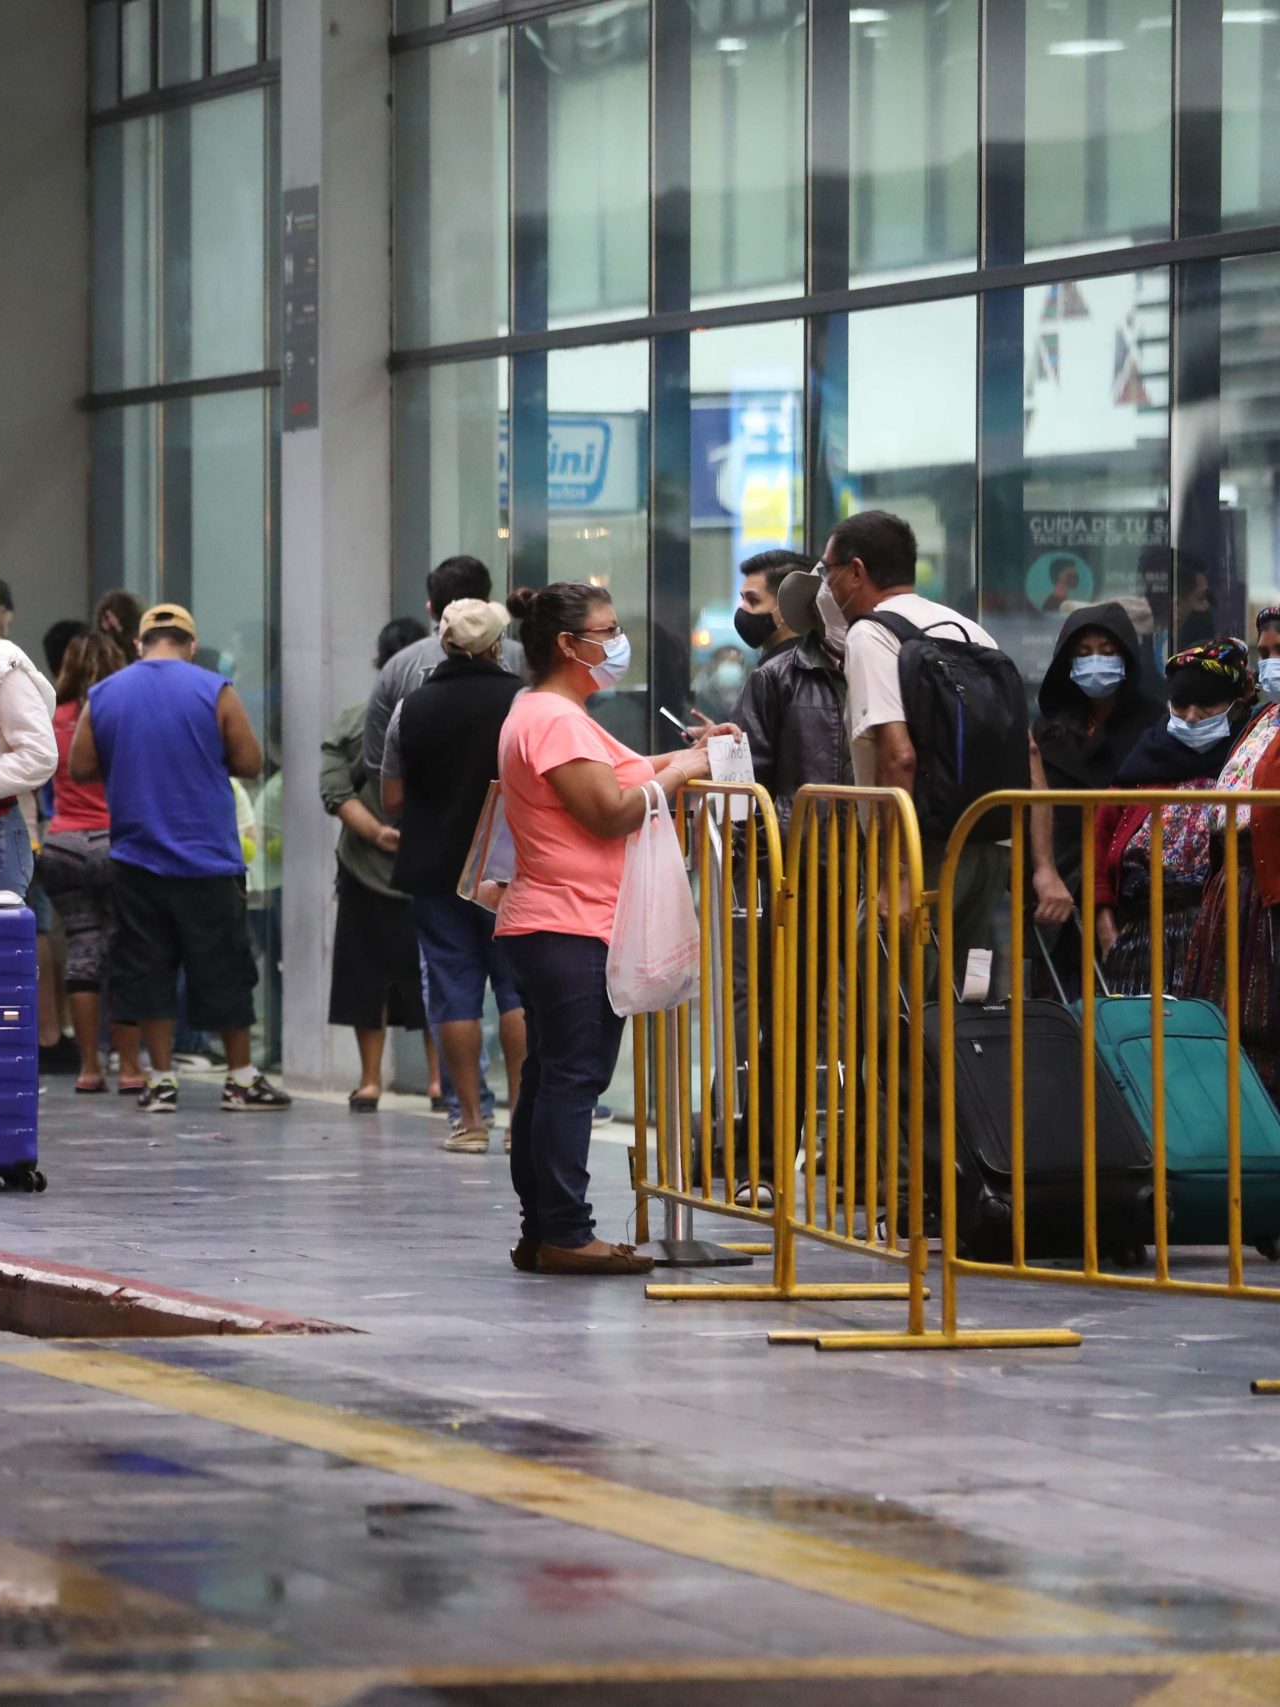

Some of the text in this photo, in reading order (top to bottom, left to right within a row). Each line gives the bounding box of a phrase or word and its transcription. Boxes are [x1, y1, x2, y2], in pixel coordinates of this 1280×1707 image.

[1092, 517, 1116, 534] DE
[1124, 517, 1148, 533] TU
[1153, 517, 1169, 533] S
[1032, 535, 1064, 547] TAKE
